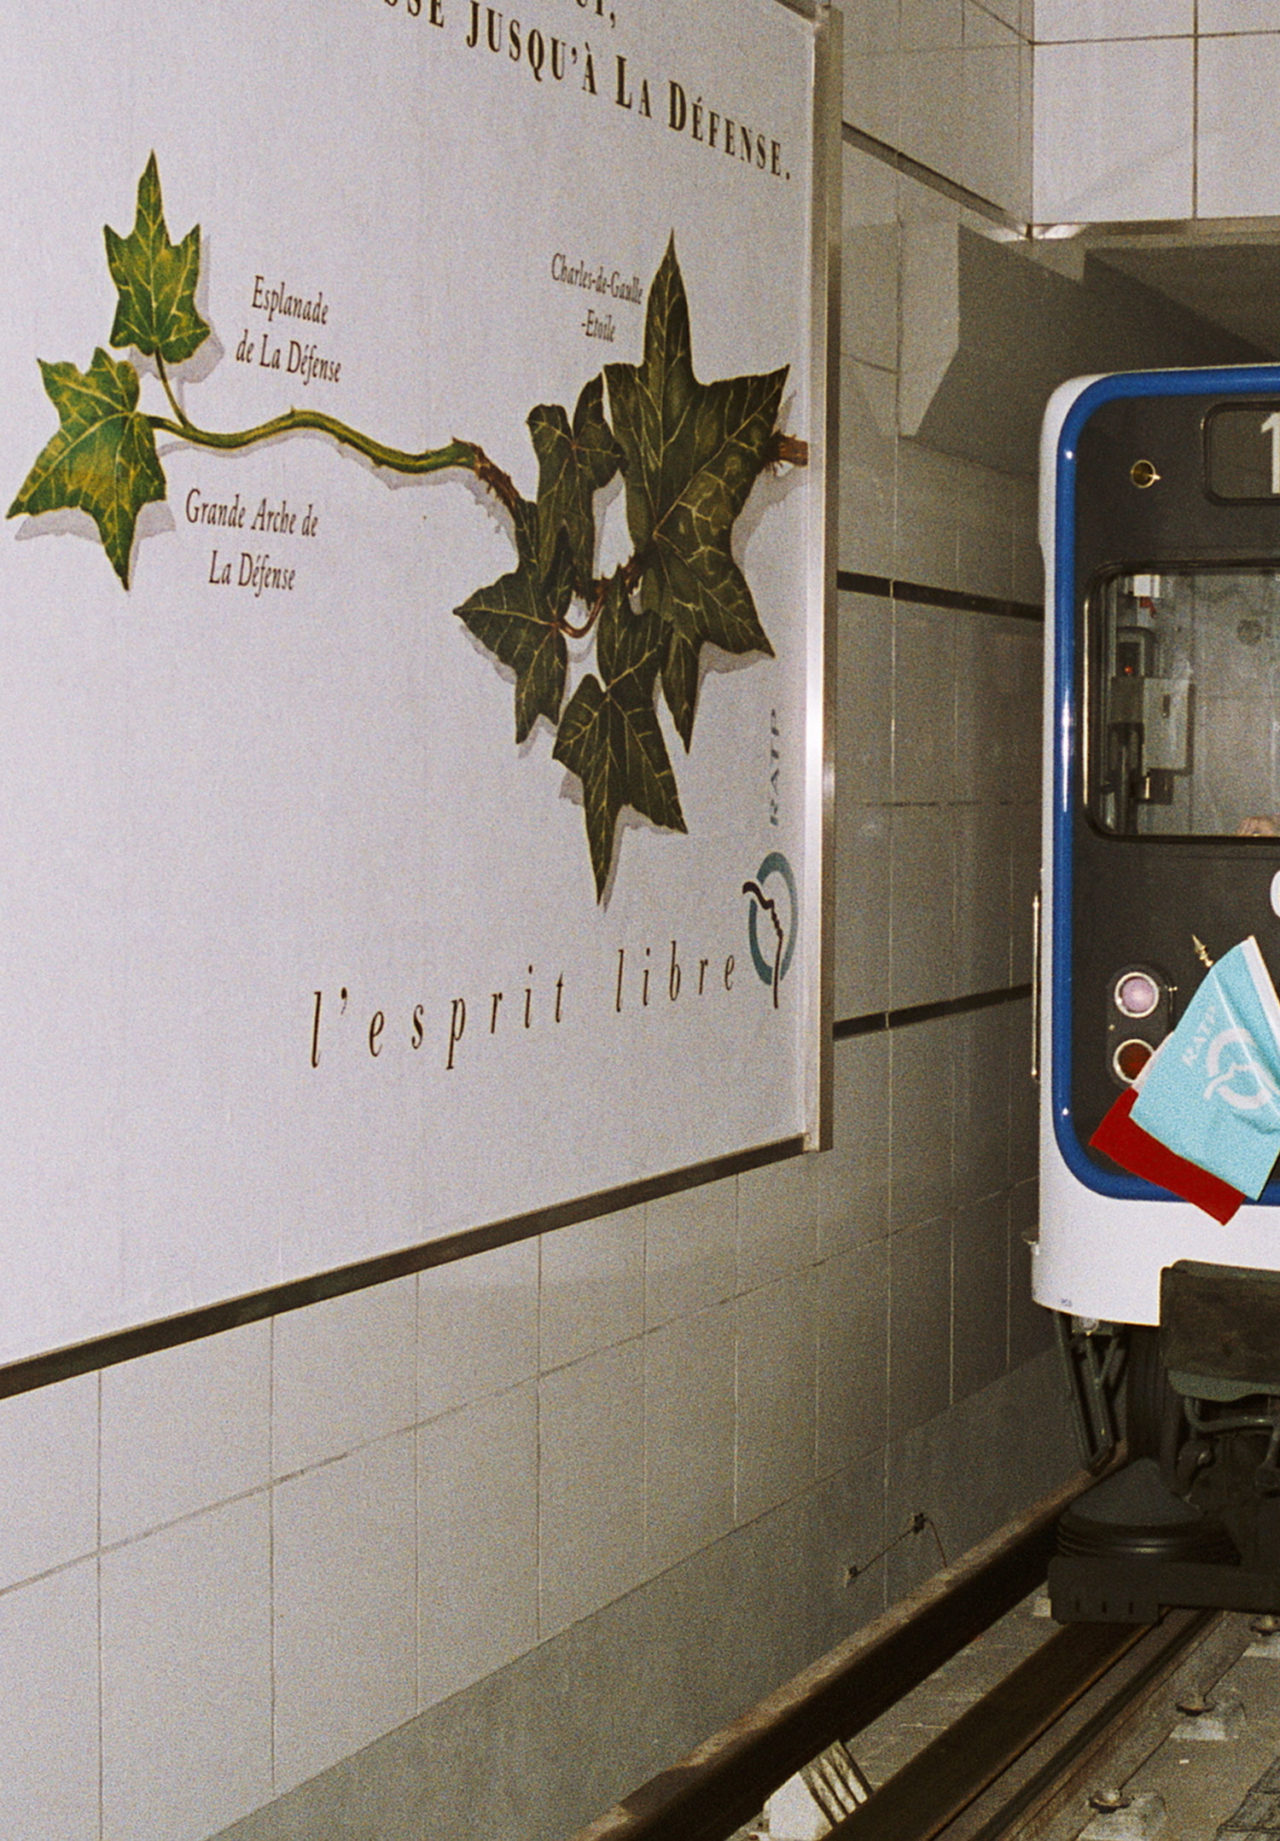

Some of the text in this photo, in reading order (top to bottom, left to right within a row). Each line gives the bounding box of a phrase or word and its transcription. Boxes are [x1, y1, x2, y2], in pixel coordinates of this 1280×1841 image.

[466, 1, 597, 95] JUSQU'À
[252, 275, 328, 325] Esplanade
[551, 253, 643, 305] Charles-de-Gaulle
[236, 328, 341, 386] de La Défense
[186, 488, 318, 537] Grande Arche de
[209, 550, 296, 598] La Défense
[769, 708, 779, 826] RATP
[312, 940, 735, 1070] l'esprit libre
